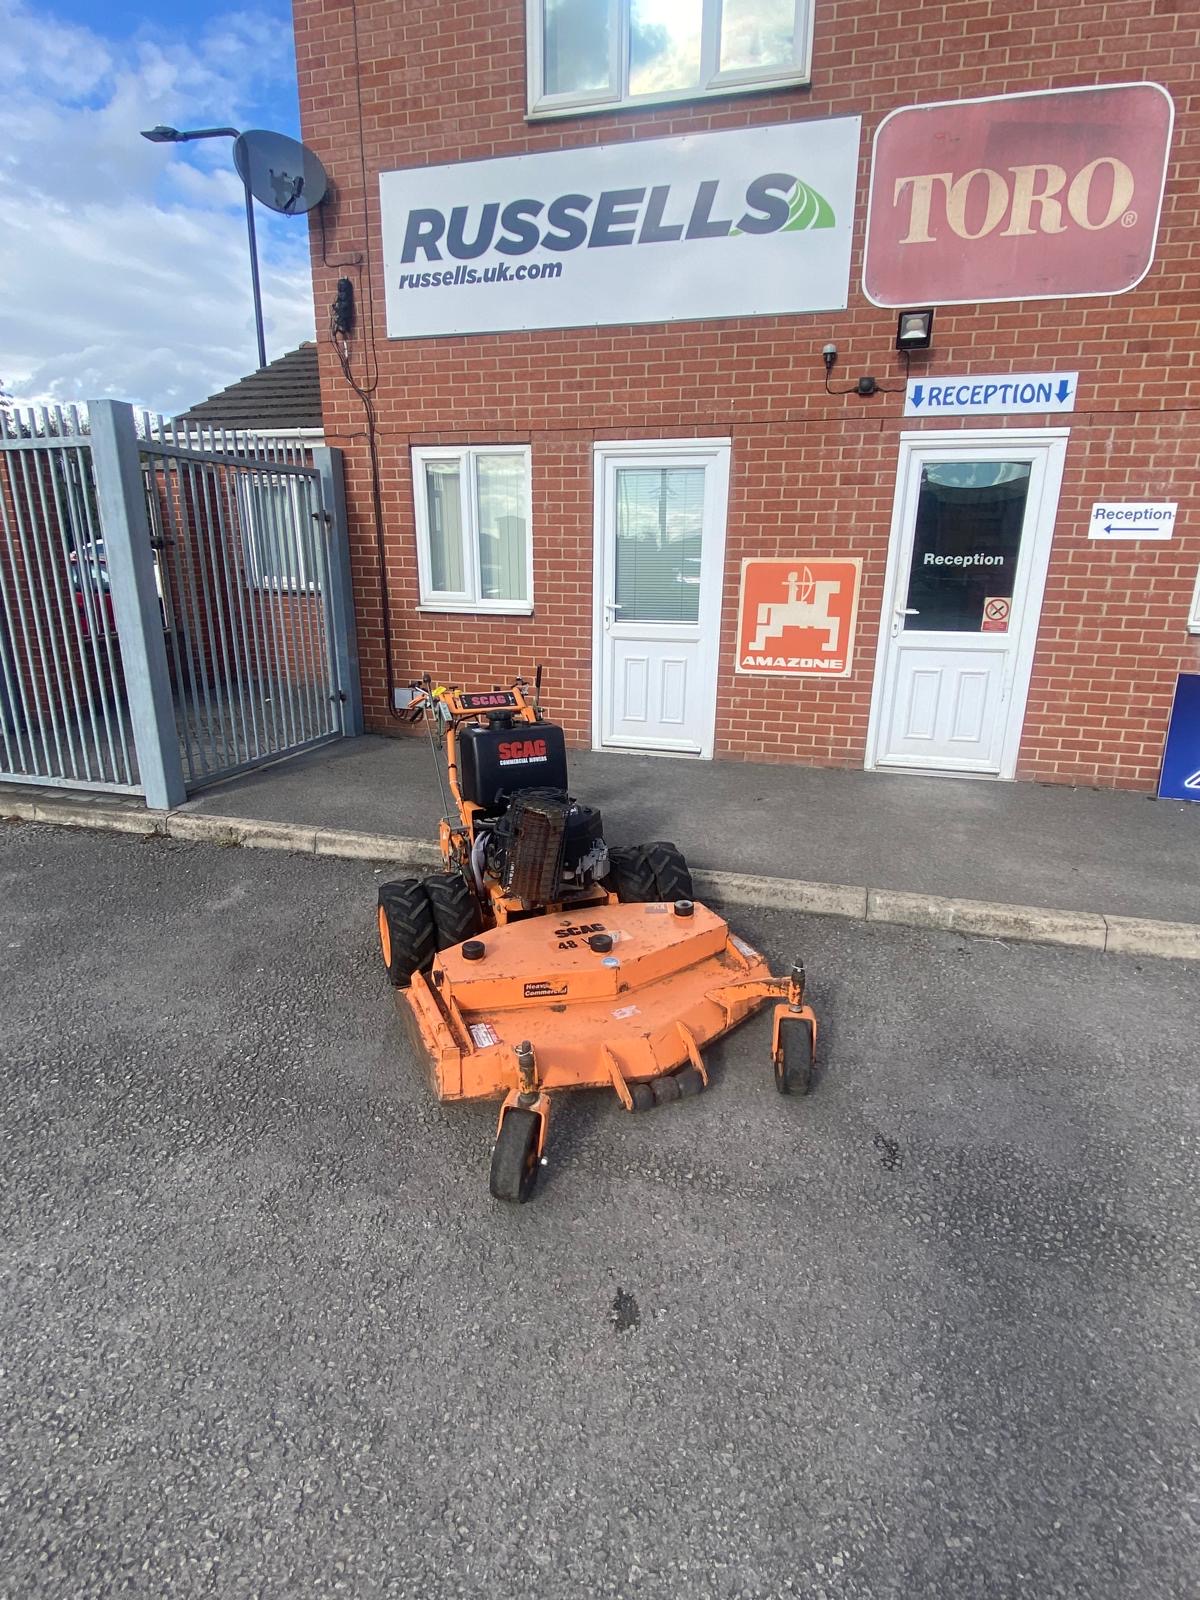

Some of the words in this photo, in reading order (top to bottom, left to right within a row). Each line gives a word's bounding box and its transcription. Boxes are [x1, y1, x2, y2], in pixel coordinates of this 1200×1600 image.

[400, 172, 799, 264] RUSSELLS
[398, 262, 563, 290] russells.uk.com
[928, 383, 1053, 406] RECEPTION
[1095, 508, 1173, 521] Reception
[923, 553, 1004, 567] Reception
[741, 655, 844, 670] AMAZONE
[471, 695, 507, 706] SCAG
[498, 739, 547, 760] SCAG
[554, 923, 607, 938] SCAG
[558, 940, 579, 950] 48
